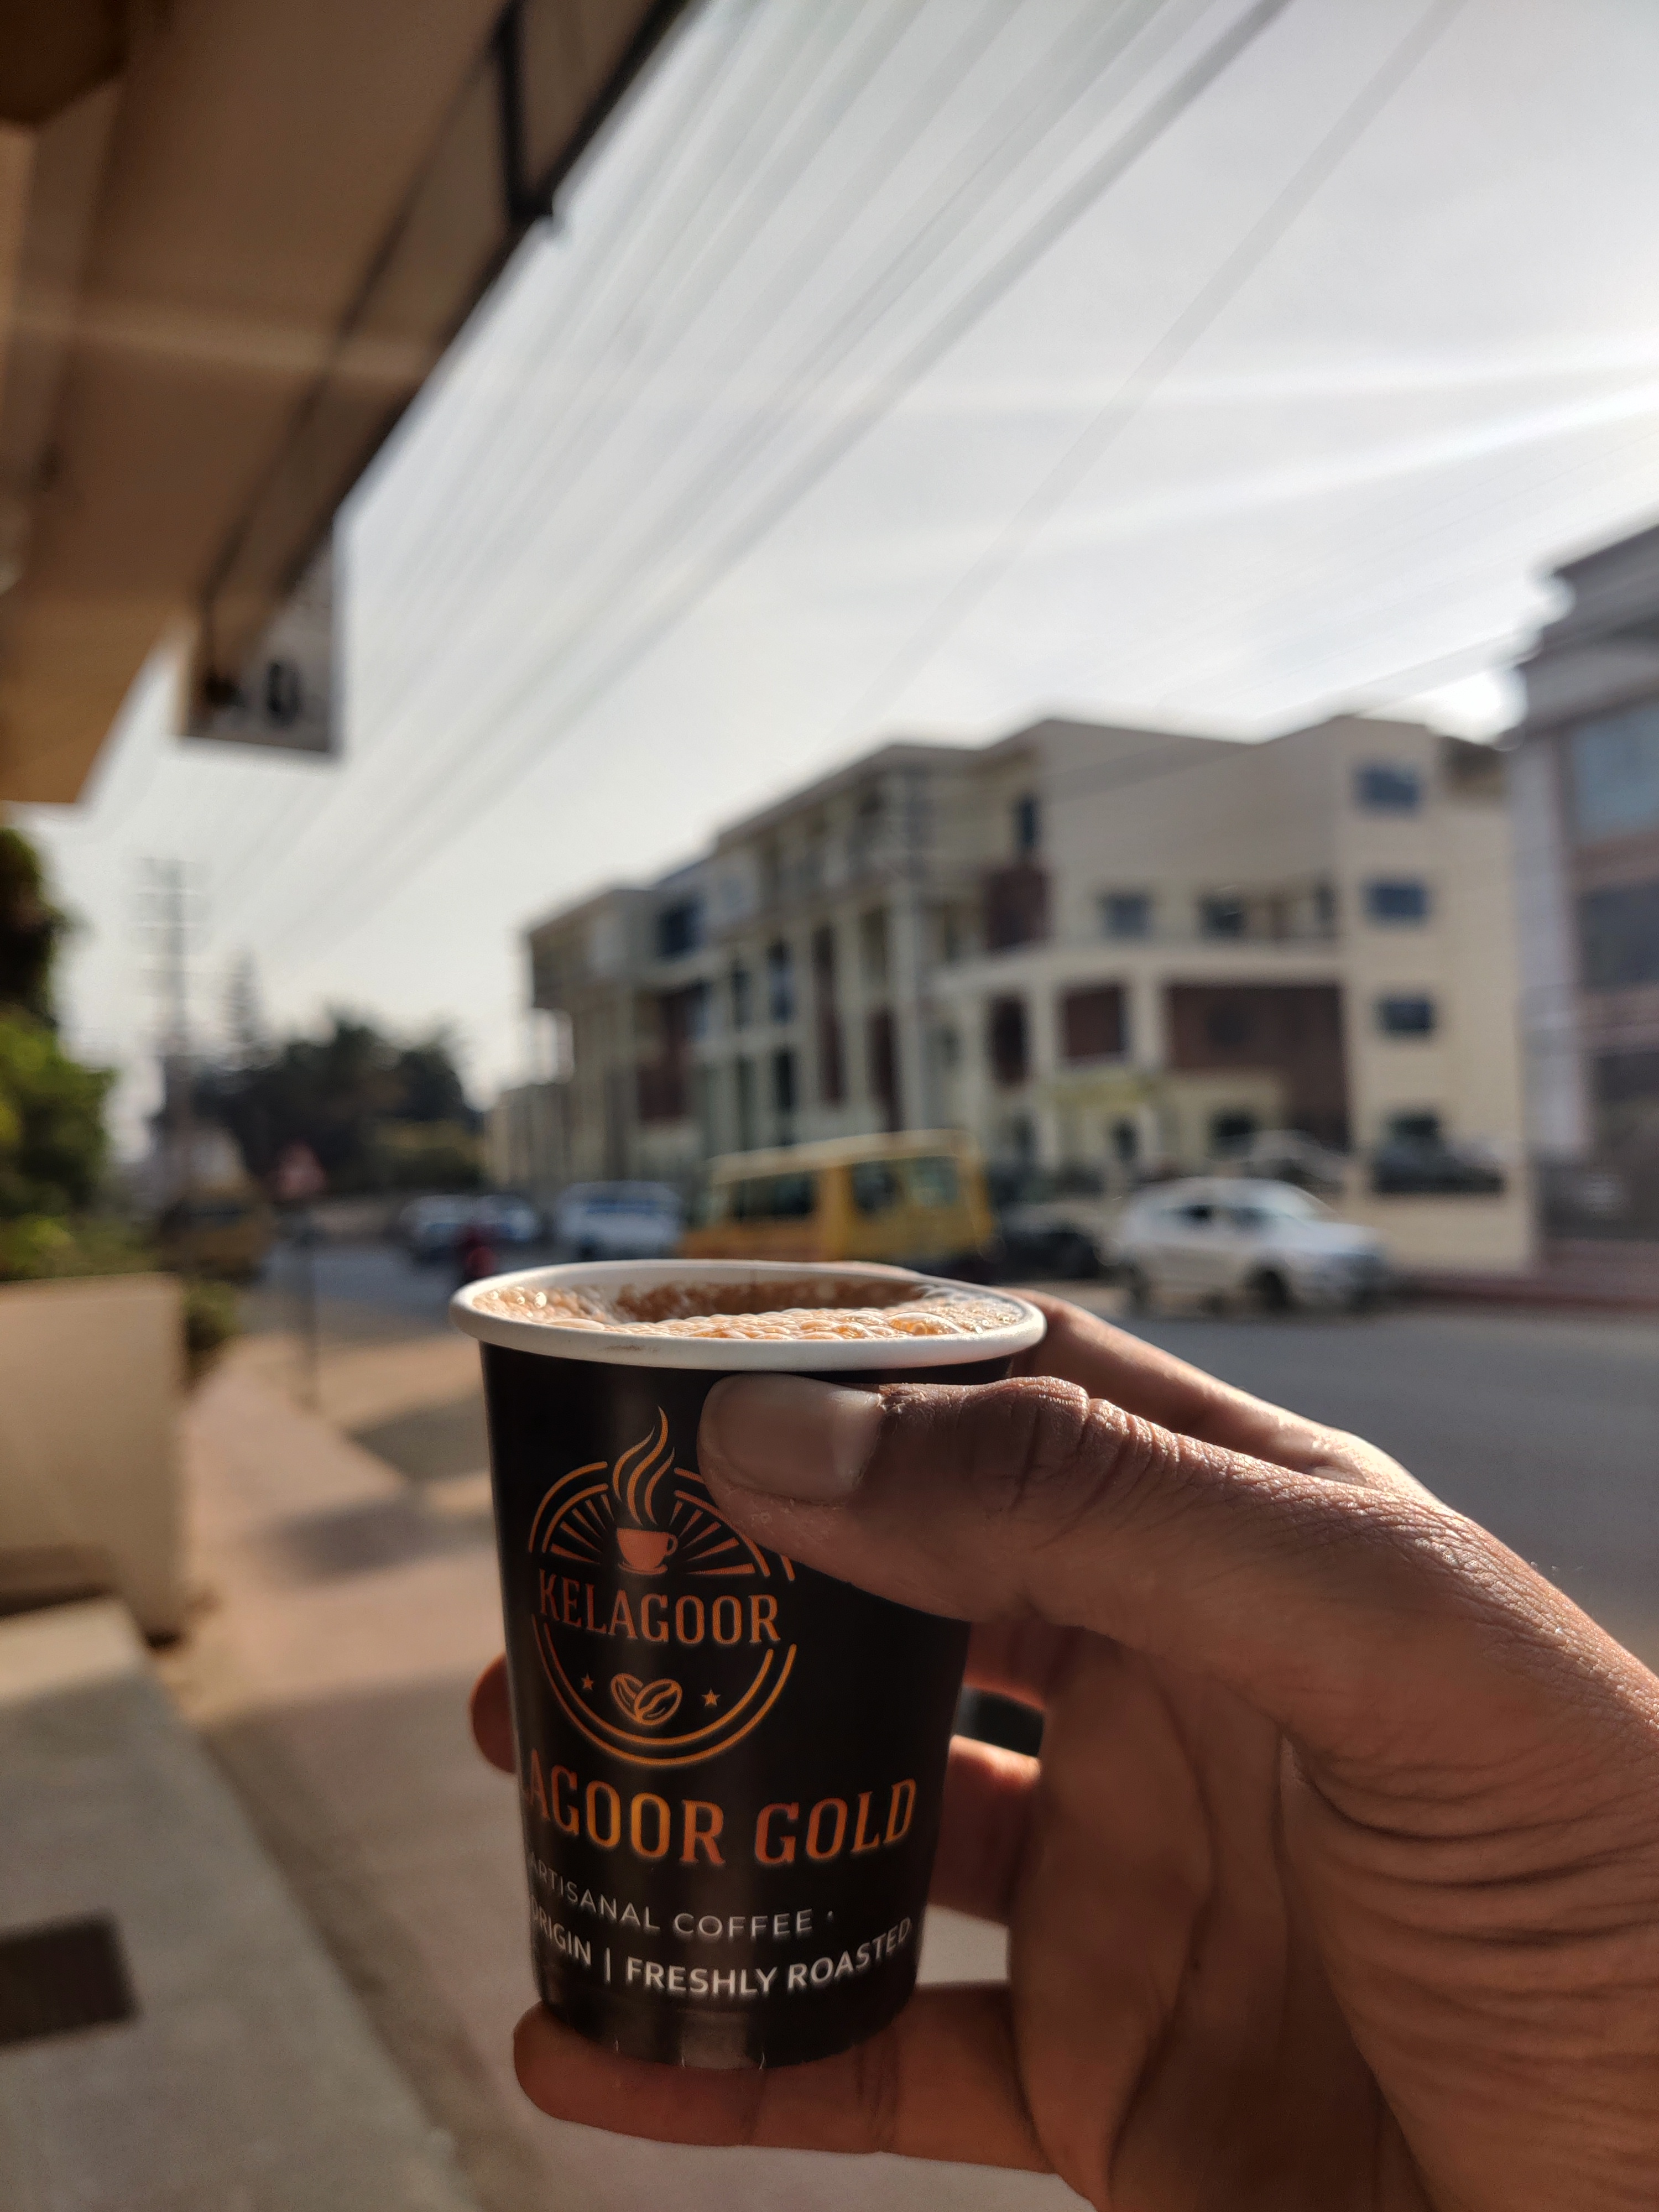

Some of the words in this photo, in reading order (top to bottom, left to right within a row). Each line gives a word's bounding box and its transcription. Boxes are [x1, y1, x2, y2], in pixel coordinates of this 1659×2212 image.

[539, 1569, 780, 1645] KELAGOOR
[526, 1749, 725, 1865] AGOOR
[754, 1778, 916, 1865] GOLD
[626, 1957, 776, 1994] FRESHLY
[787, 1917, 914, 1990] ROASTED
[673, 1908, 814, 1938] COFFEE
